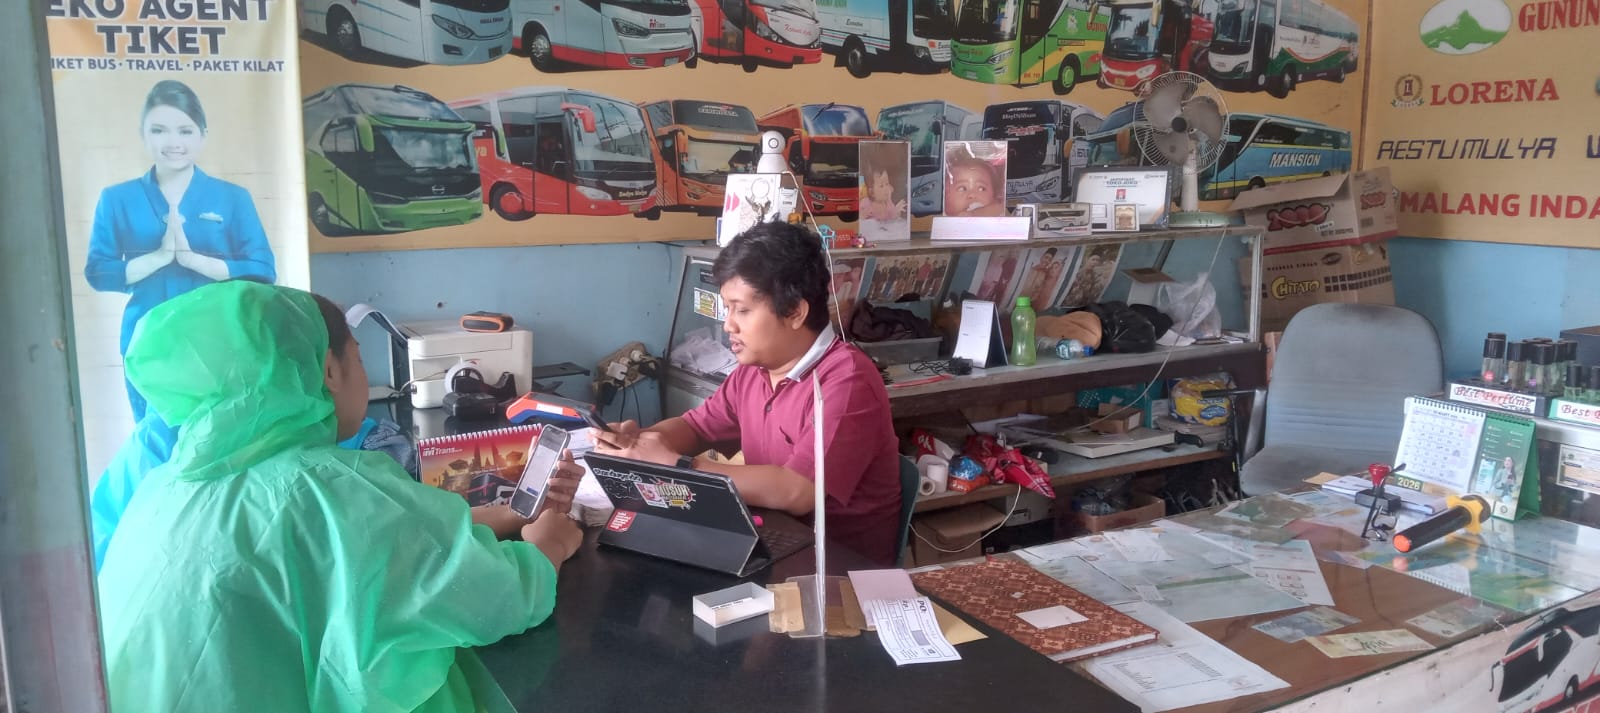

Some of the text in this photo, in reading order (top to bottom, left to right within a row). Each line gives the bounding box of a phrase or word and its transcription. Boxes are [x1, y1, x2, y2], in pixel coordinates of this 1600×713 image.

[139, 0, 268, 20] AGENT
[97, 25, 226, 54] TIKET
[51, 58, 284, 72] IKET BUS TRAVEL PAKET KILAT
[1430, 78, 1560, 106] LORENA
[1269, 152, 1321, 168] MANSION
[1400, 191, 1520, 216] MALANG
[1561, 404, 1590, 417] Best
[1397, 477, 1421, 490] 2026
